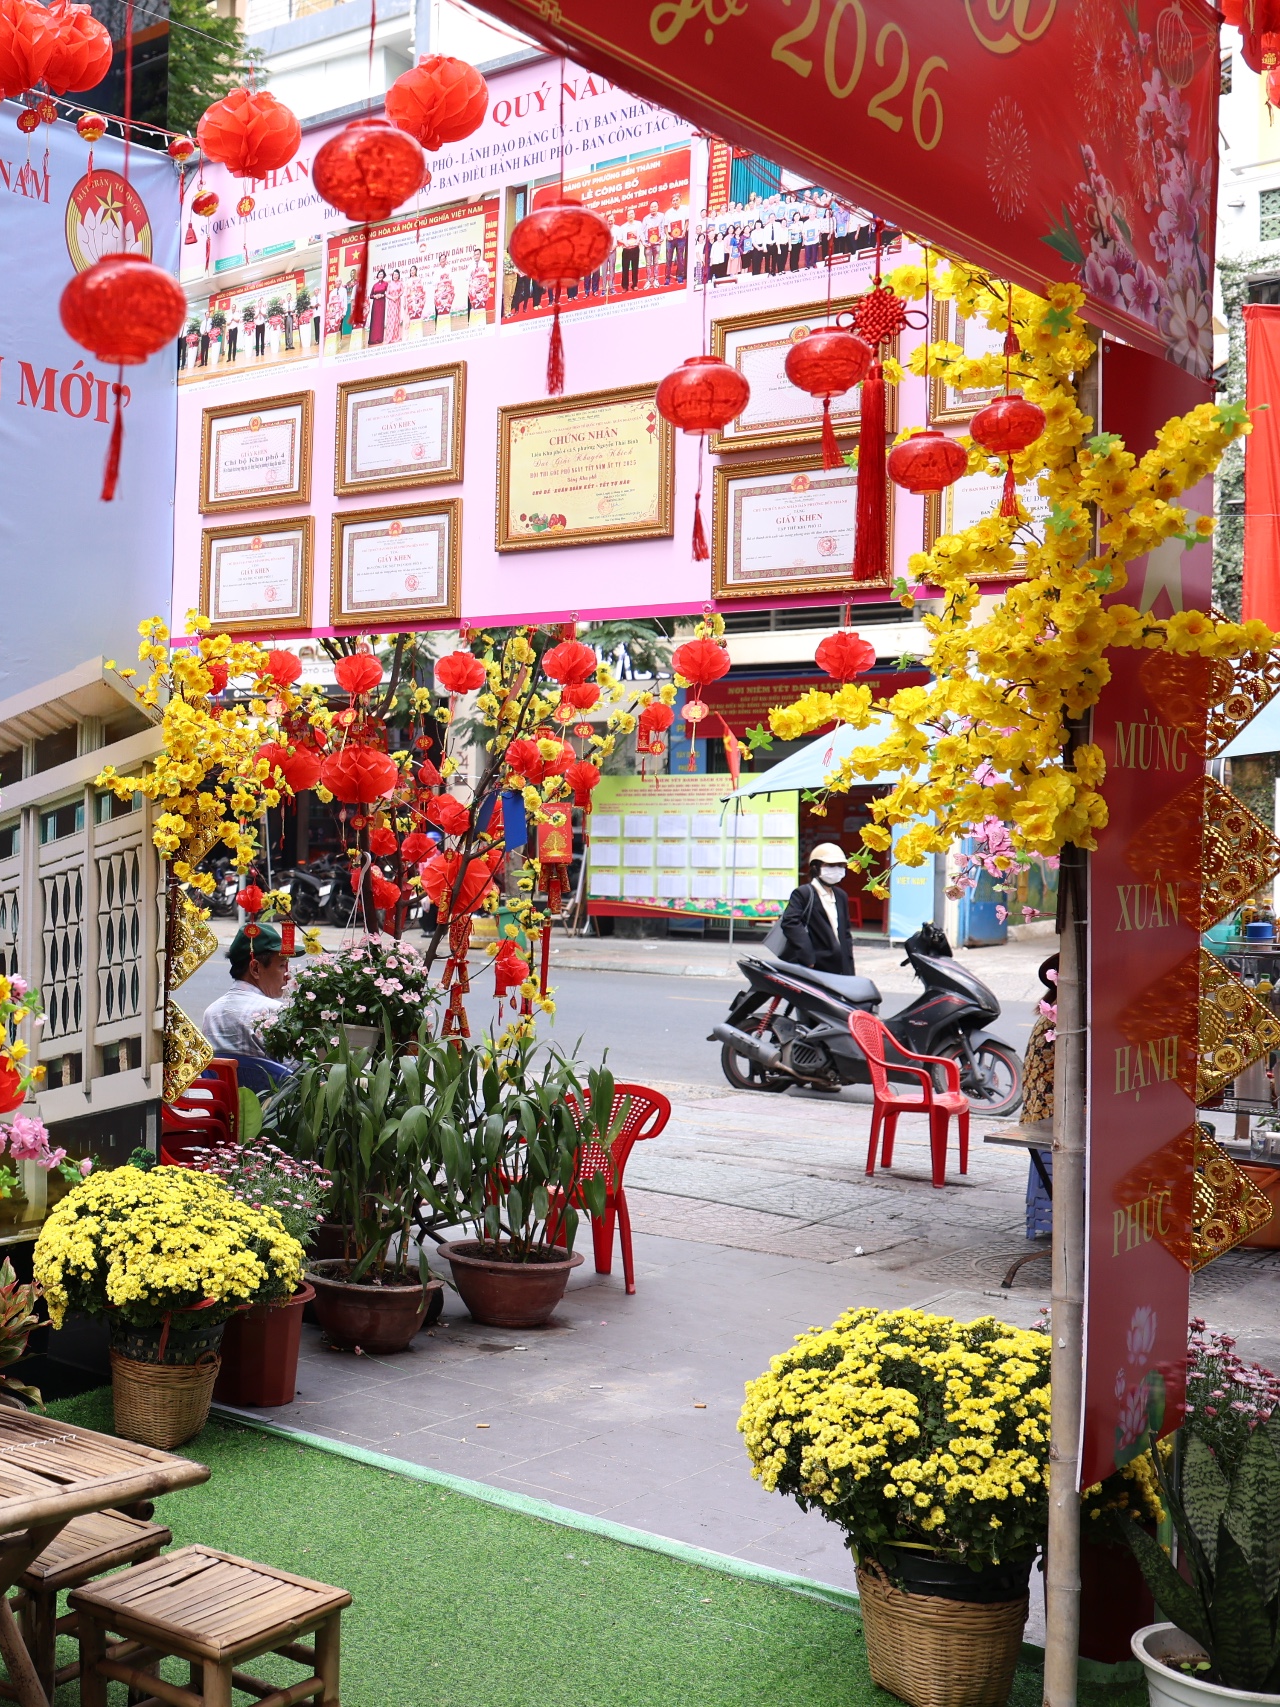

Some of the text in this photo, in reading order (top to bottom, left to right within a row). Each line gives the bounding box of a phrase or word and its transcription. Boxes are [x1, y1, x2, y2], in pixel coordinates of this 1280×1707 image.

[492, 81, 552, 127] QUÝ
[771, 0, 949, 151] 2026
[212, 216, 237, 234] QUAN
[258, 204, 277, 220] CỦA
[277, 197, 297, 215] CÁC
[461, 143, 490, 165] LÃNH
[492, 139, 516, 157] ĐẠO
[518, 128, 549, 149] ĐẢNG
[576, 115, 592, 133] ỦY
[594, 110, 618, 128] BAN
[439, 173, 461, 191] BAN
[462, 164, 487, 185] ĐIỀU
[489, 157, 521, 179] HÀNH
[524, 149, 548, 169] KHU
[582, 135, 606, 153] BAN
[608, 124, 642, 146] CÔNG
[645, 115, 670, 136] TÁC
[467, 205, 484, 216] NAM
[594, 182, 623, 197] CÔNG
[549, 427, 618, 446] CHỨNG NHẬN
[799, 513, 823, 523] KHEN
[1112, 708, 1188, 773] MỪNG
[1115, 869, 1181, 932] XUÂN
[1114, 1035, 1179, 1102] HẠNH
[1111, 1181, 1171, 1258] PHÚC
